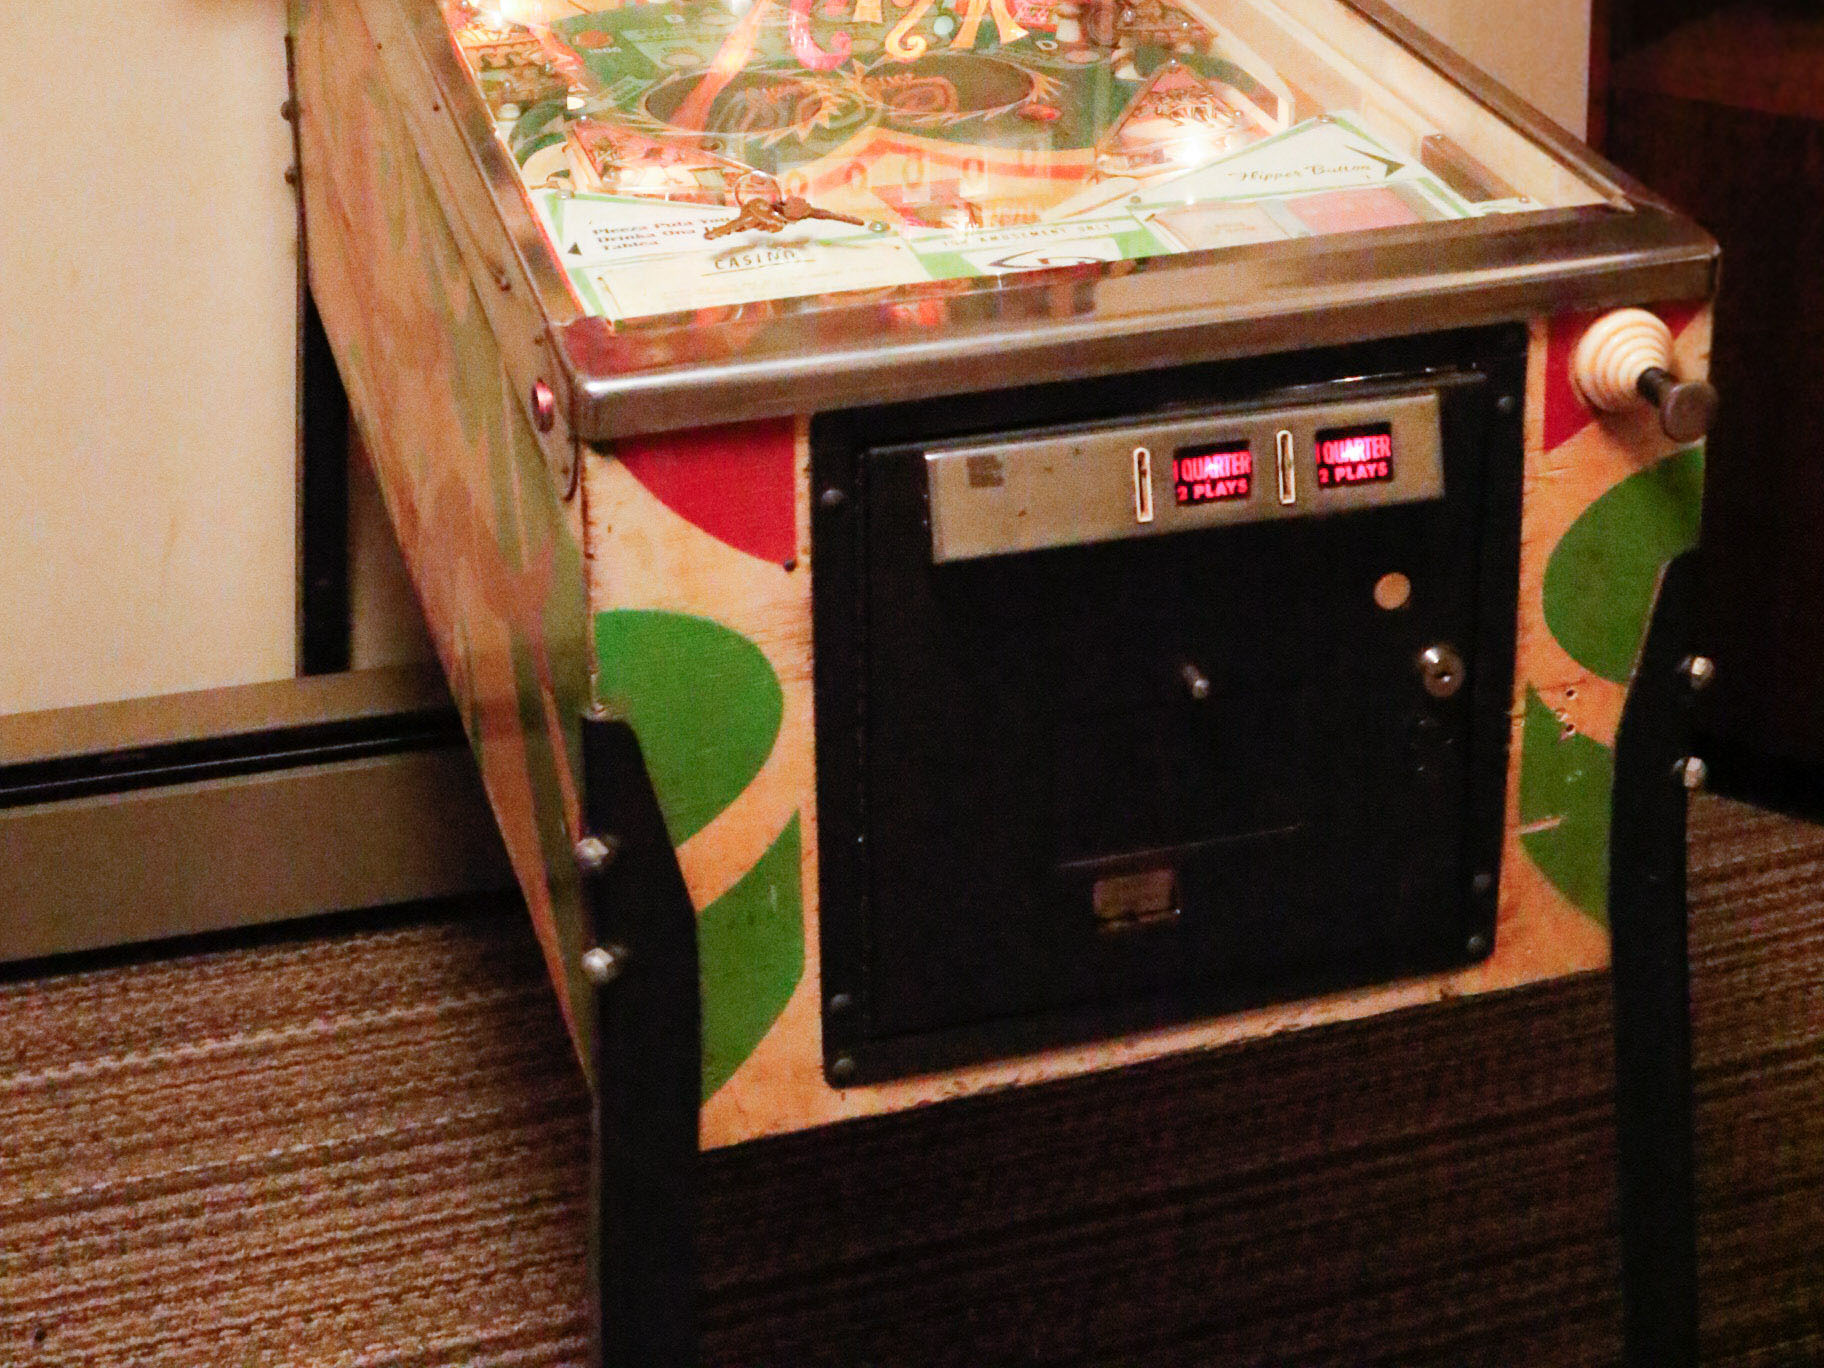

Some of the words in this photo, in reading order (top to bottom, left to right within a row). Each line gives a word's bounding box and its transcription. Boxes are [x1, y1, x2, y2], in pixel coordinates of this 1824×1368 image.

[1322, 434, 1392, 465] QUARTER
[1181, 451, 1252, 482] QUARTER
[1318, 468, 1329, 484] 2
[1333, 461, 1389, 482] PLAYS
[1177, 485, 1188, 501] 2
[1193, 478, 1248, 500] PLAYS
